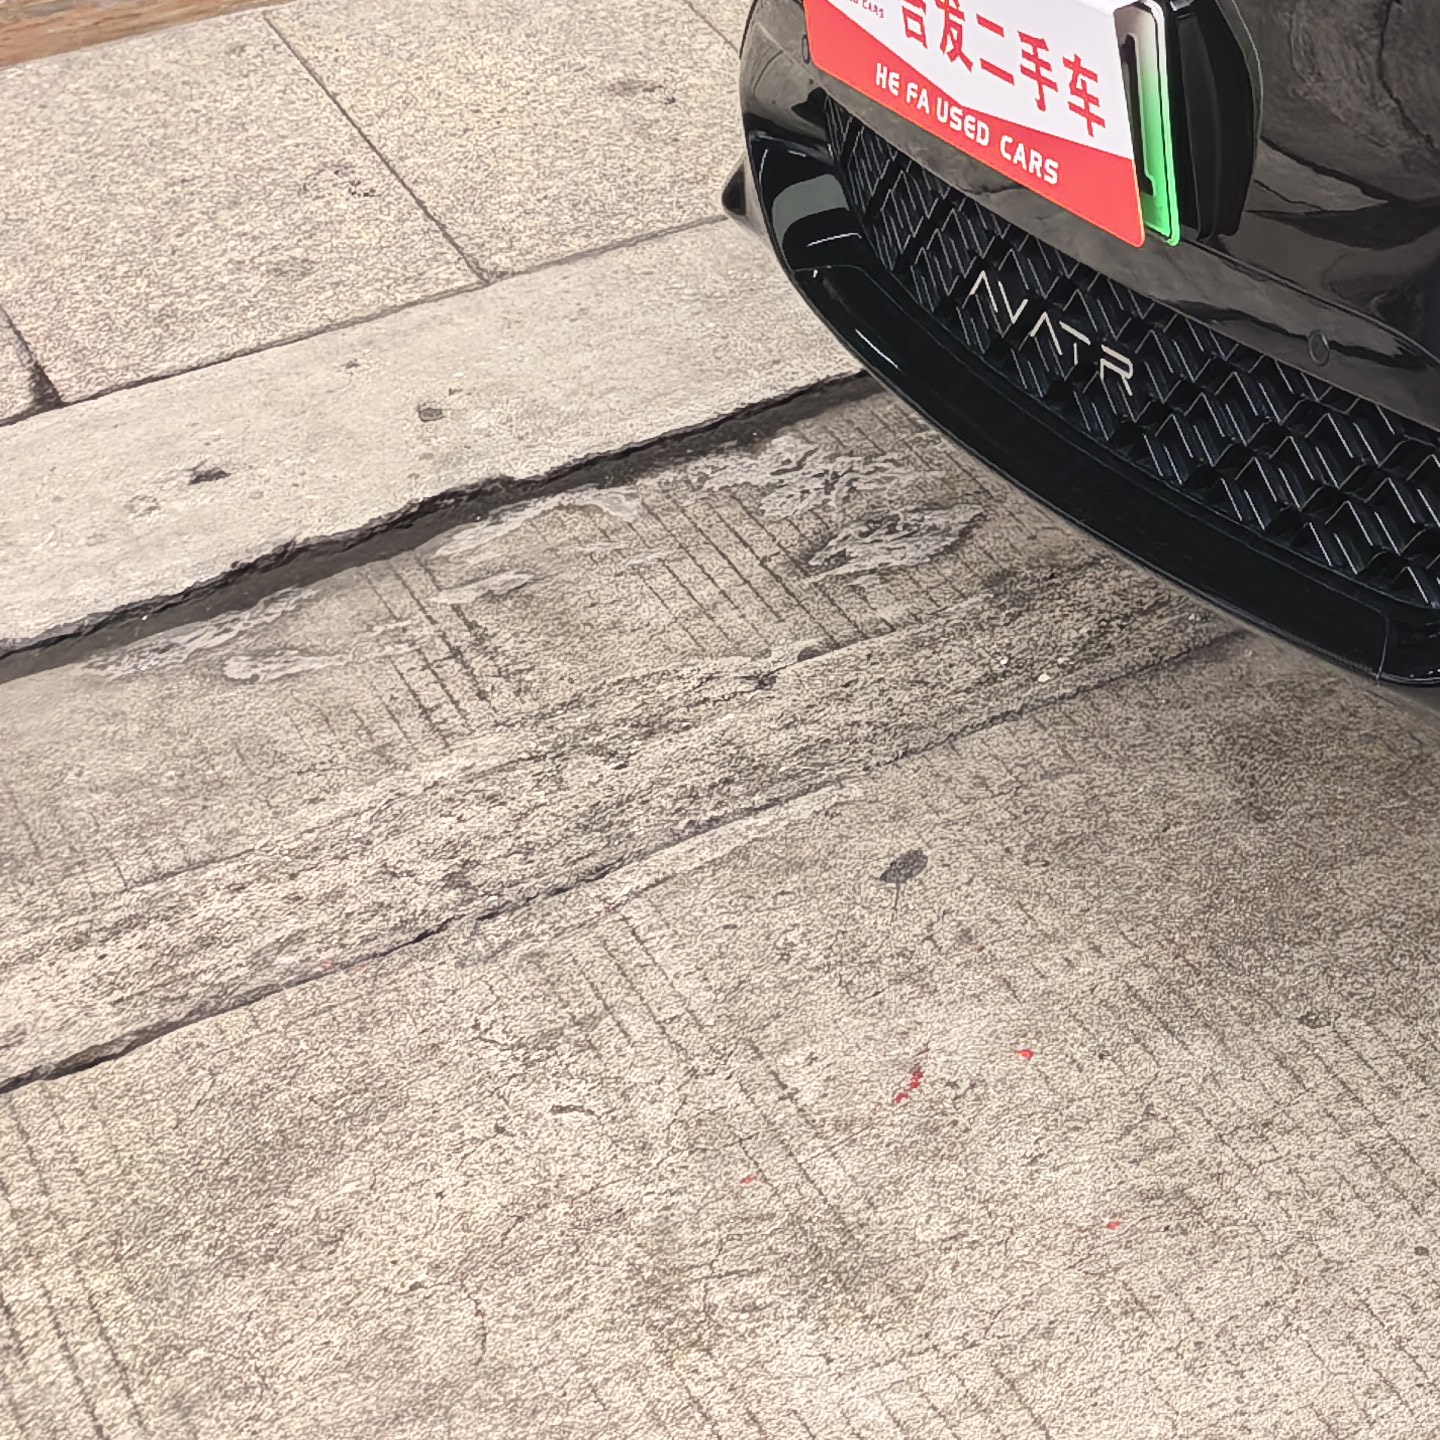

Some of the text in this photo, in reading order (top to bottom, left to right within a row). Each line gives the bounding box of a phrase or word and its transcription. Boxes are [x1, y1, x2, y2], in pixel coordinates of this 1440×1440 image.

[875, 63, 1060, 187] HE FA USED CARS
[969, 270, 1134, 397] AVATR
